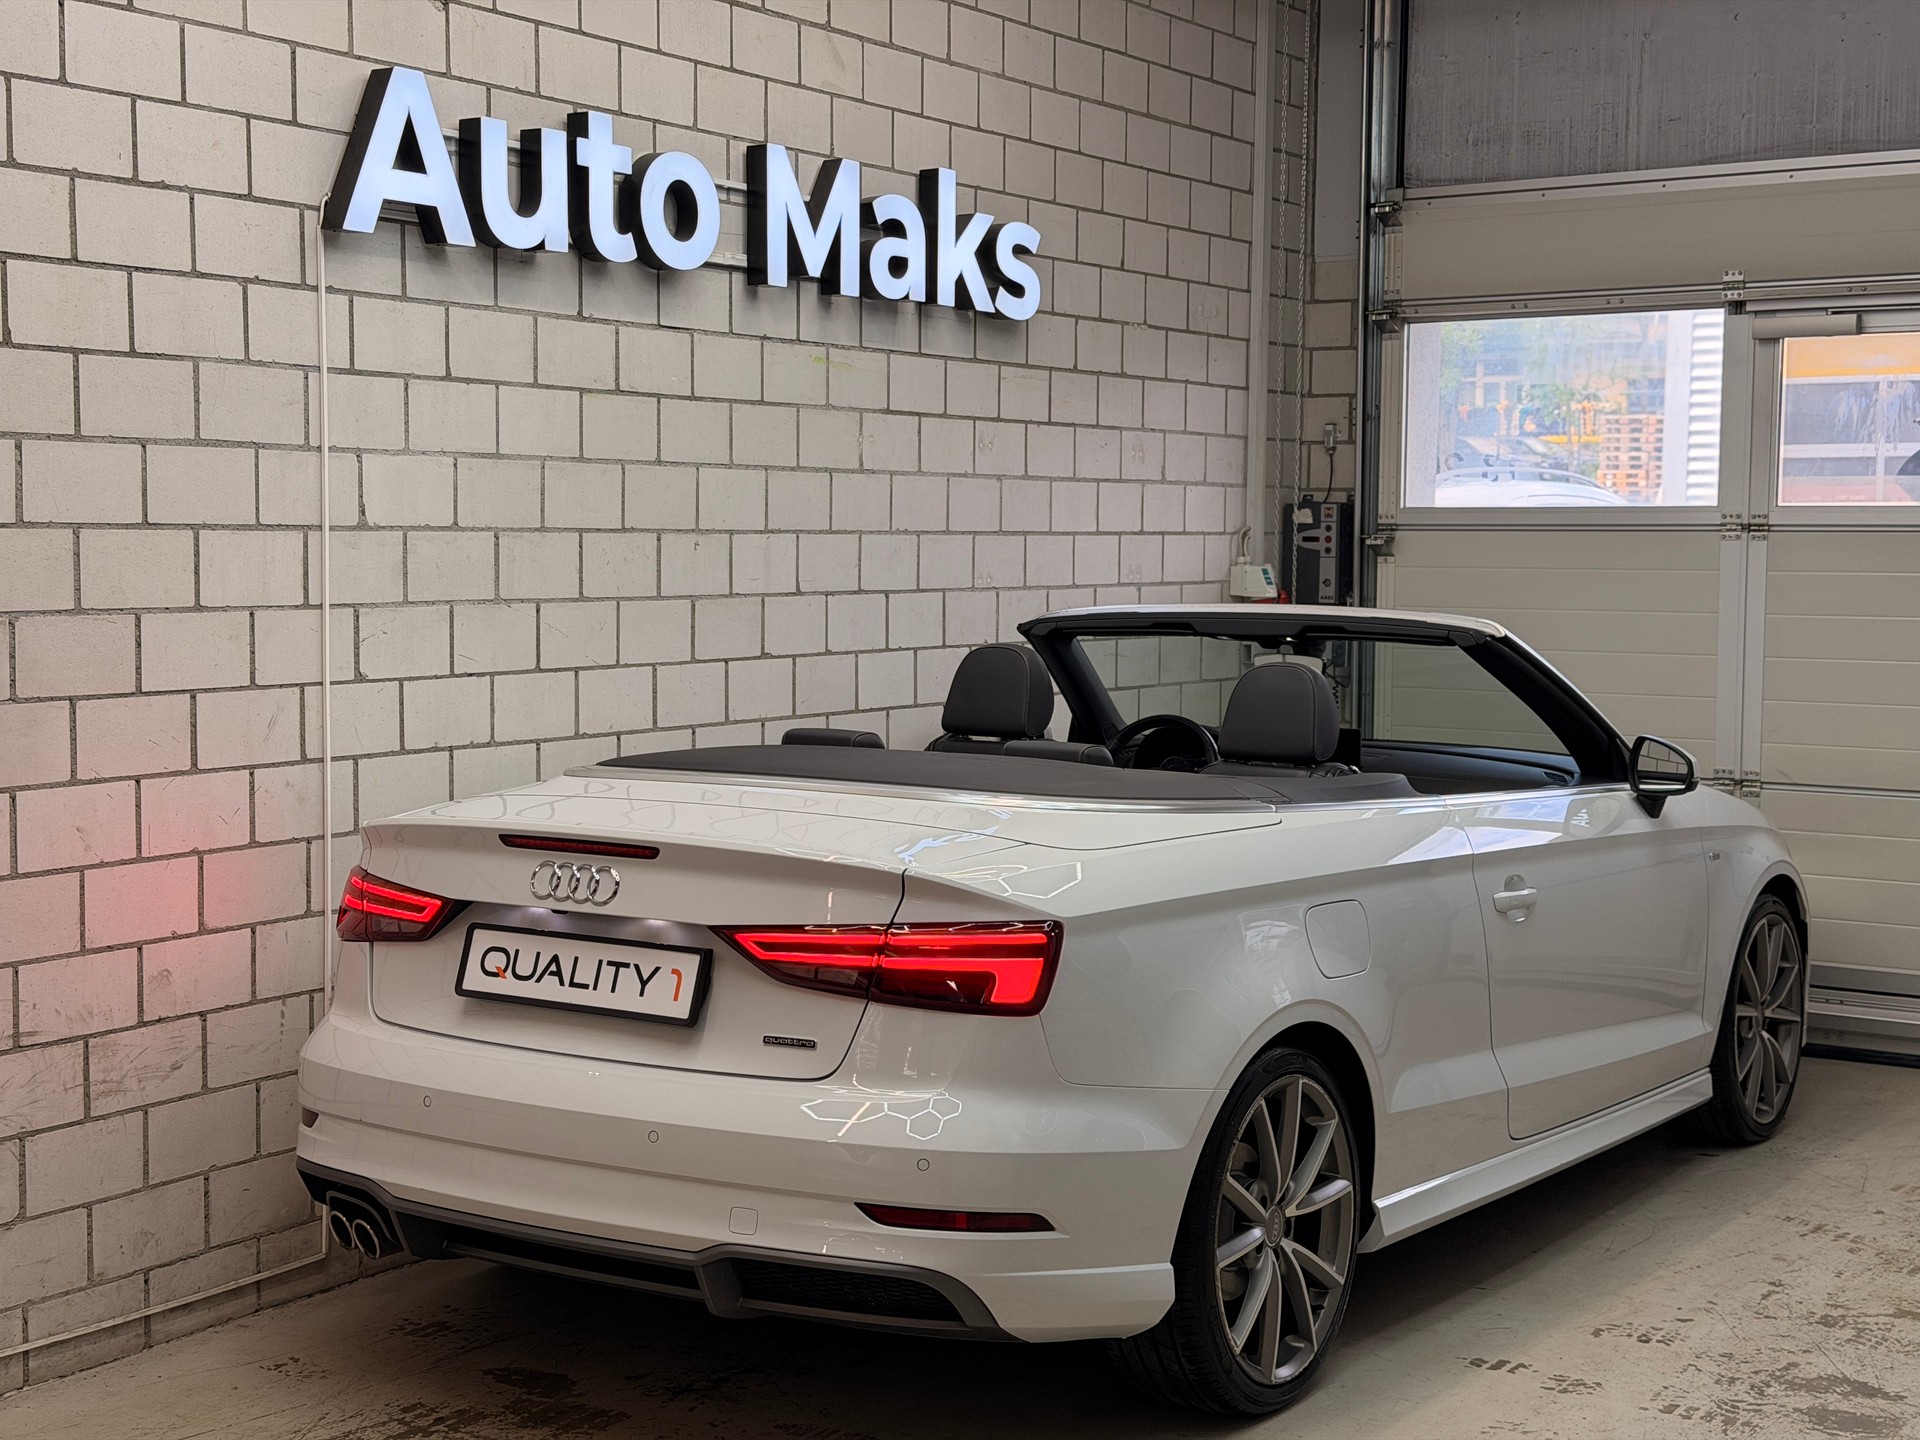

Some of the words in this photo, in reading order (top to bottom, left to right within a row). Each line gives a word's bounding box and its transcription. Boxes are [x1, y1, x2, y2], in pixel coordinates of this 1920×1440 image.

[341, 65, 721, 271] Auto
[765, 142, 1042, 322] Maks
[480, 945, 662, 998] QUALITY
[670, 968, 683, 1002] 1
[764, 1036, 815, 1048] quattro
